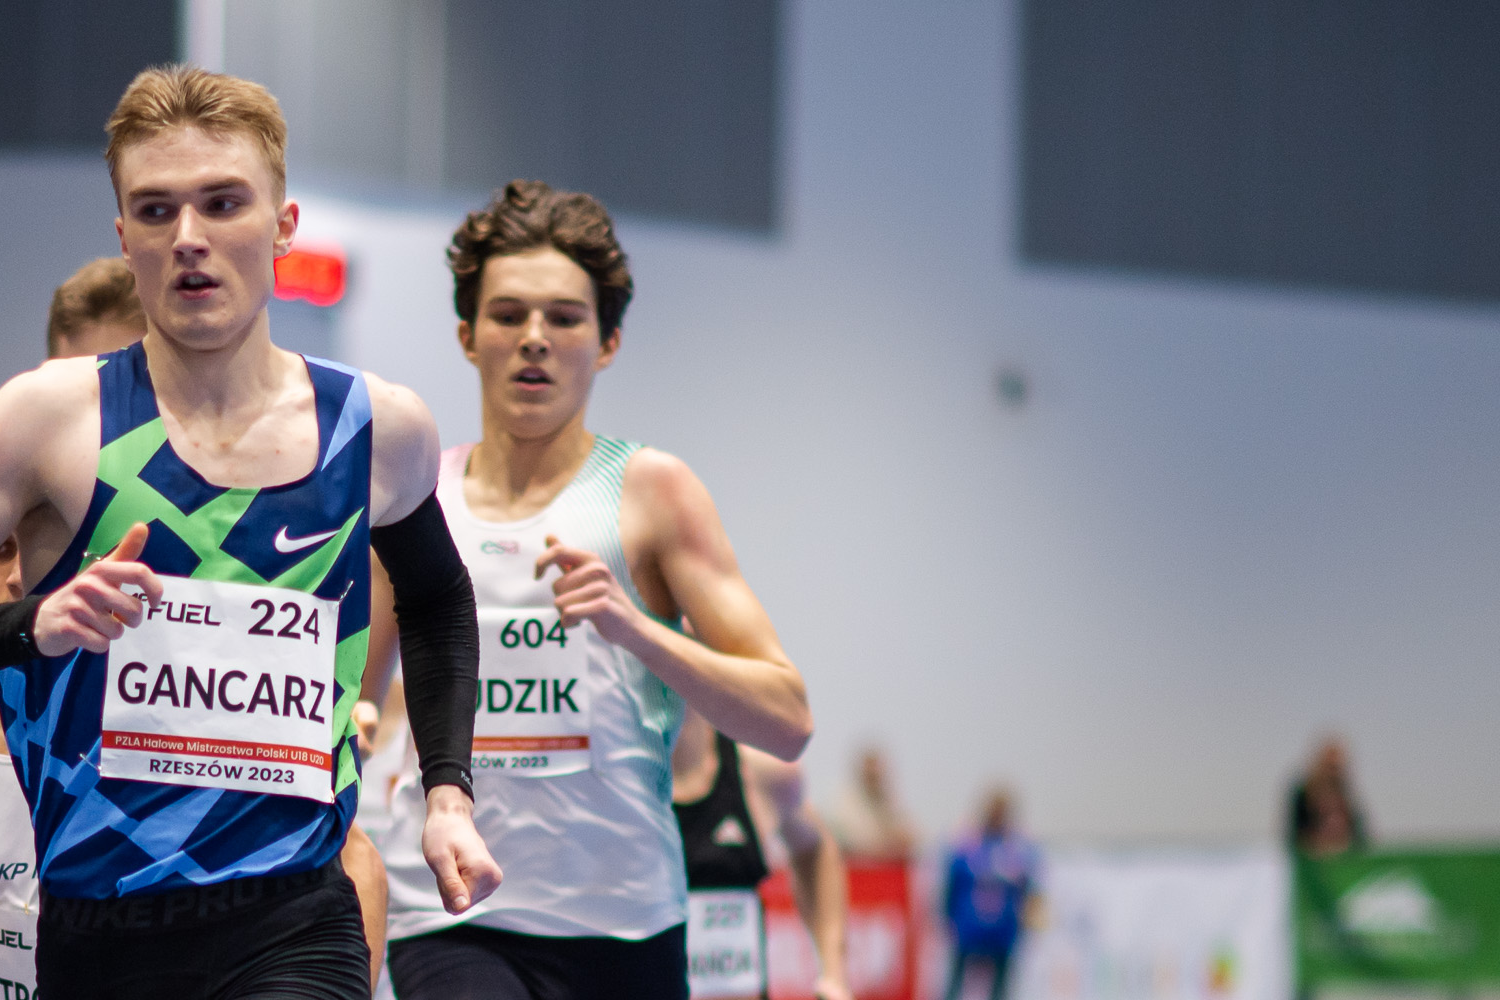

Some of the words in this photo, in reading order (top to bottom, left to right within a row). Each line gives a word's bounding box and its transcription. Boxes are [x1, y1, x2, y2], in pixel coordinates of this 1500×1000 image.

[147, 601, 221, 627] FUEL
[248, 598, 320, 645] 224
[500, 618, 568, 649] 604
[117, 661, 326, 725] GANCARZ
[115, 735, 141, 747] PZLA
[143, 738, 184, 751] Halowe
[186, 741, 254, 757] Mistrzostwa
[256, 747, 289, 760] Polski
[290, 750, 308, 762] U18
[310, 754, 325, 766] U20
[511, 755, 549, 769] 2023
[149, 759, 244, 780] RZESZÓW
[247, 766, 295, 784] 2023
